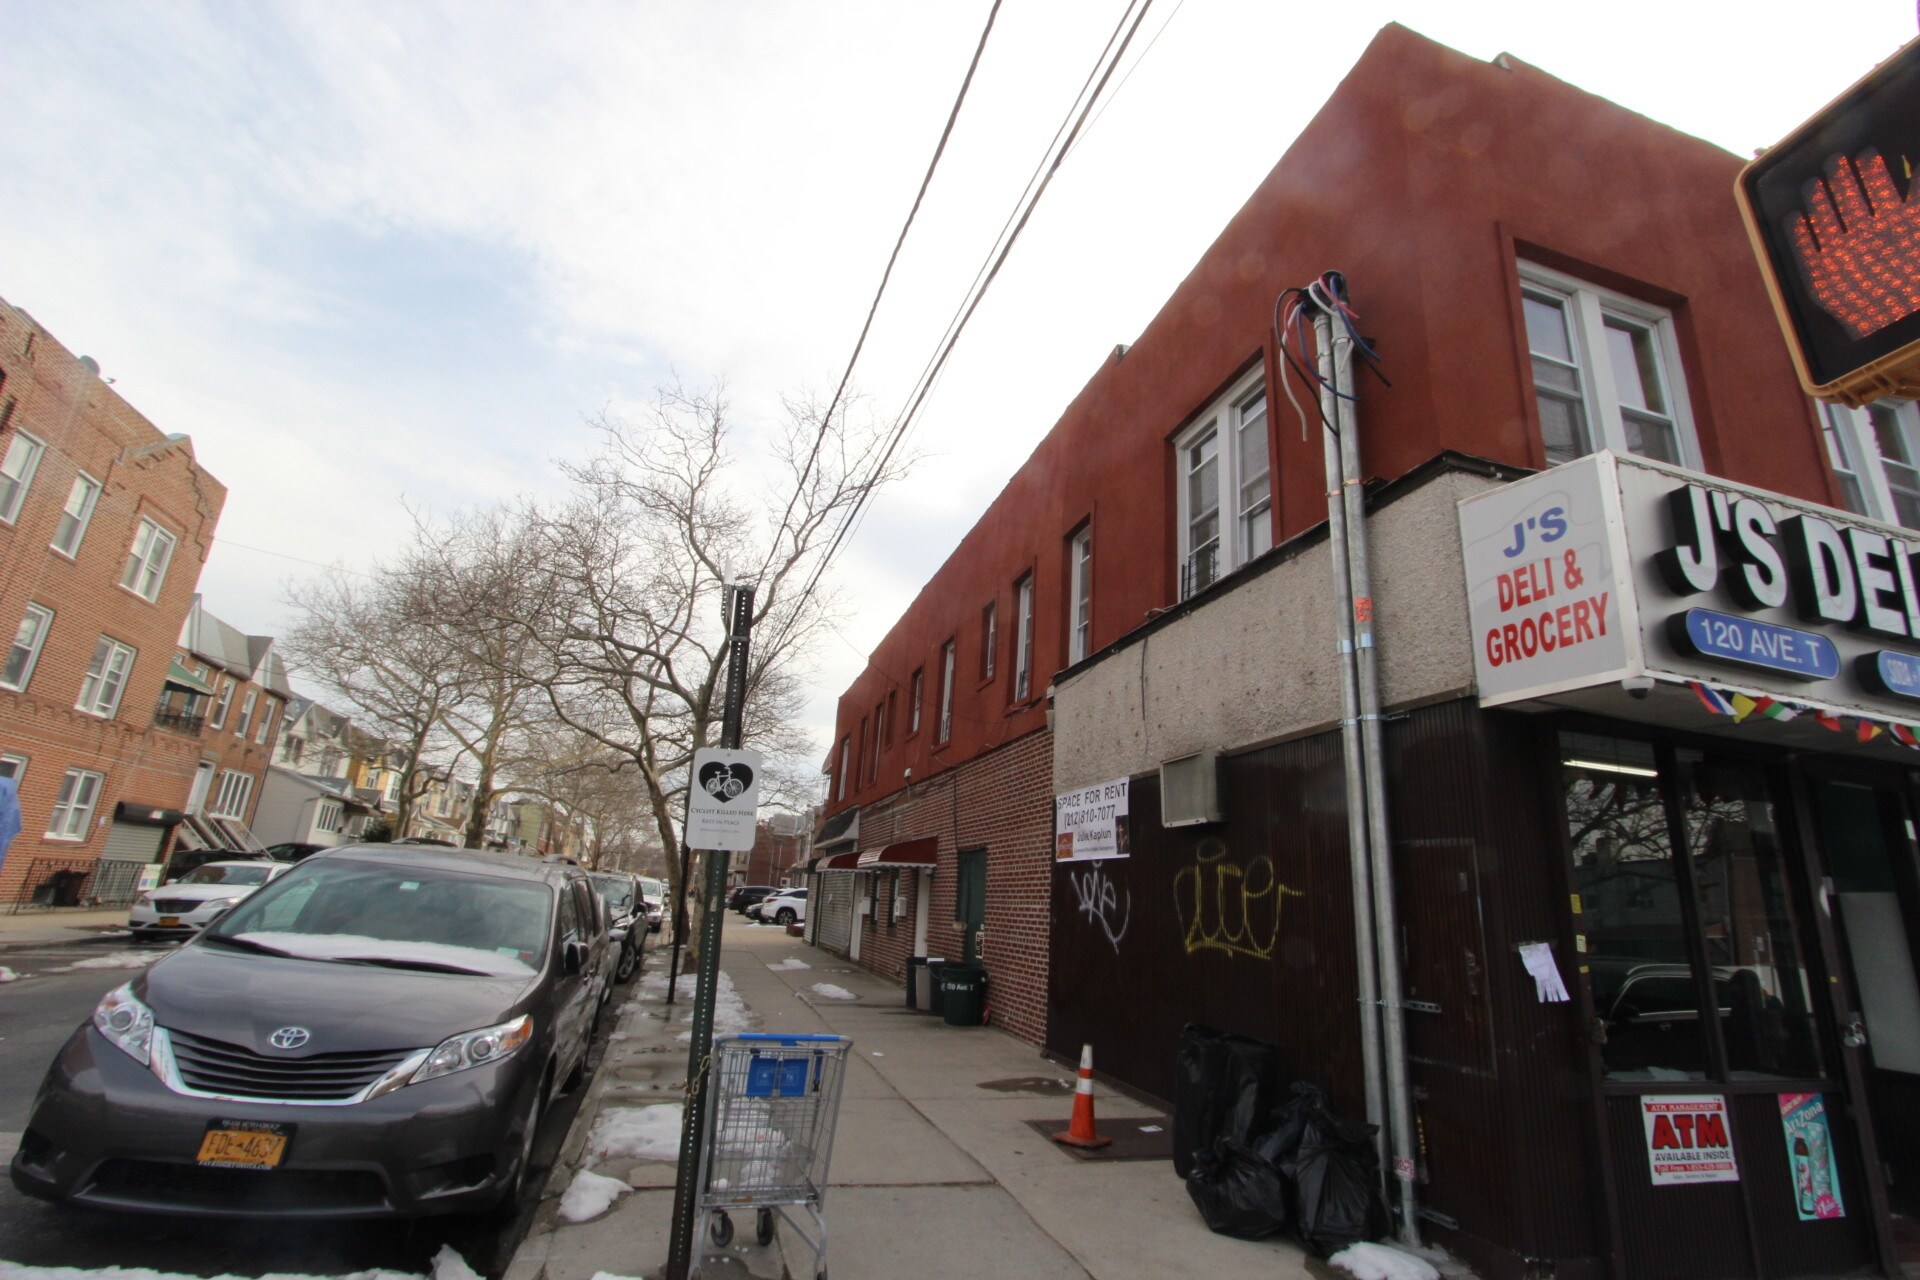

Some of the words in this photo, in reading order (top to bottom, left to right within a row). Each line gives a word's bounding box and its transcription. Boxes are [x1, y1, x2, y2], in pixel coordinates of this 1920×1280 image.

[1503, 507, 1567, 558] J'S
[1670, 484, 1788, 608] J'S
[1497, 557, 1555, 613] DELI
[1564, 548, 1584, 590] &
[1486, 591, 1609, 668] GROCERY
[1701, 618, 1743, 651] 120
[1750, 628, 1803, 664] AVE.
[1805, 640, 1820, 668] T
[1058, 793, 1081, 810] SPACE
[1085, 789, 1101, 805] FOR
[1104, 782, 1127, 800] RENT
[1077, 830, 1089, 842] Julie
[1090, 828, 1112, 842] Kaplun
[1651, 1103, 1667, 1112] ATM
[1651, 1113, 1729, 1150] ATM
[1655, 1151, 1700, 1162] AVAILABLE
[1703, 1150, 1731, 1160] INSIDE
